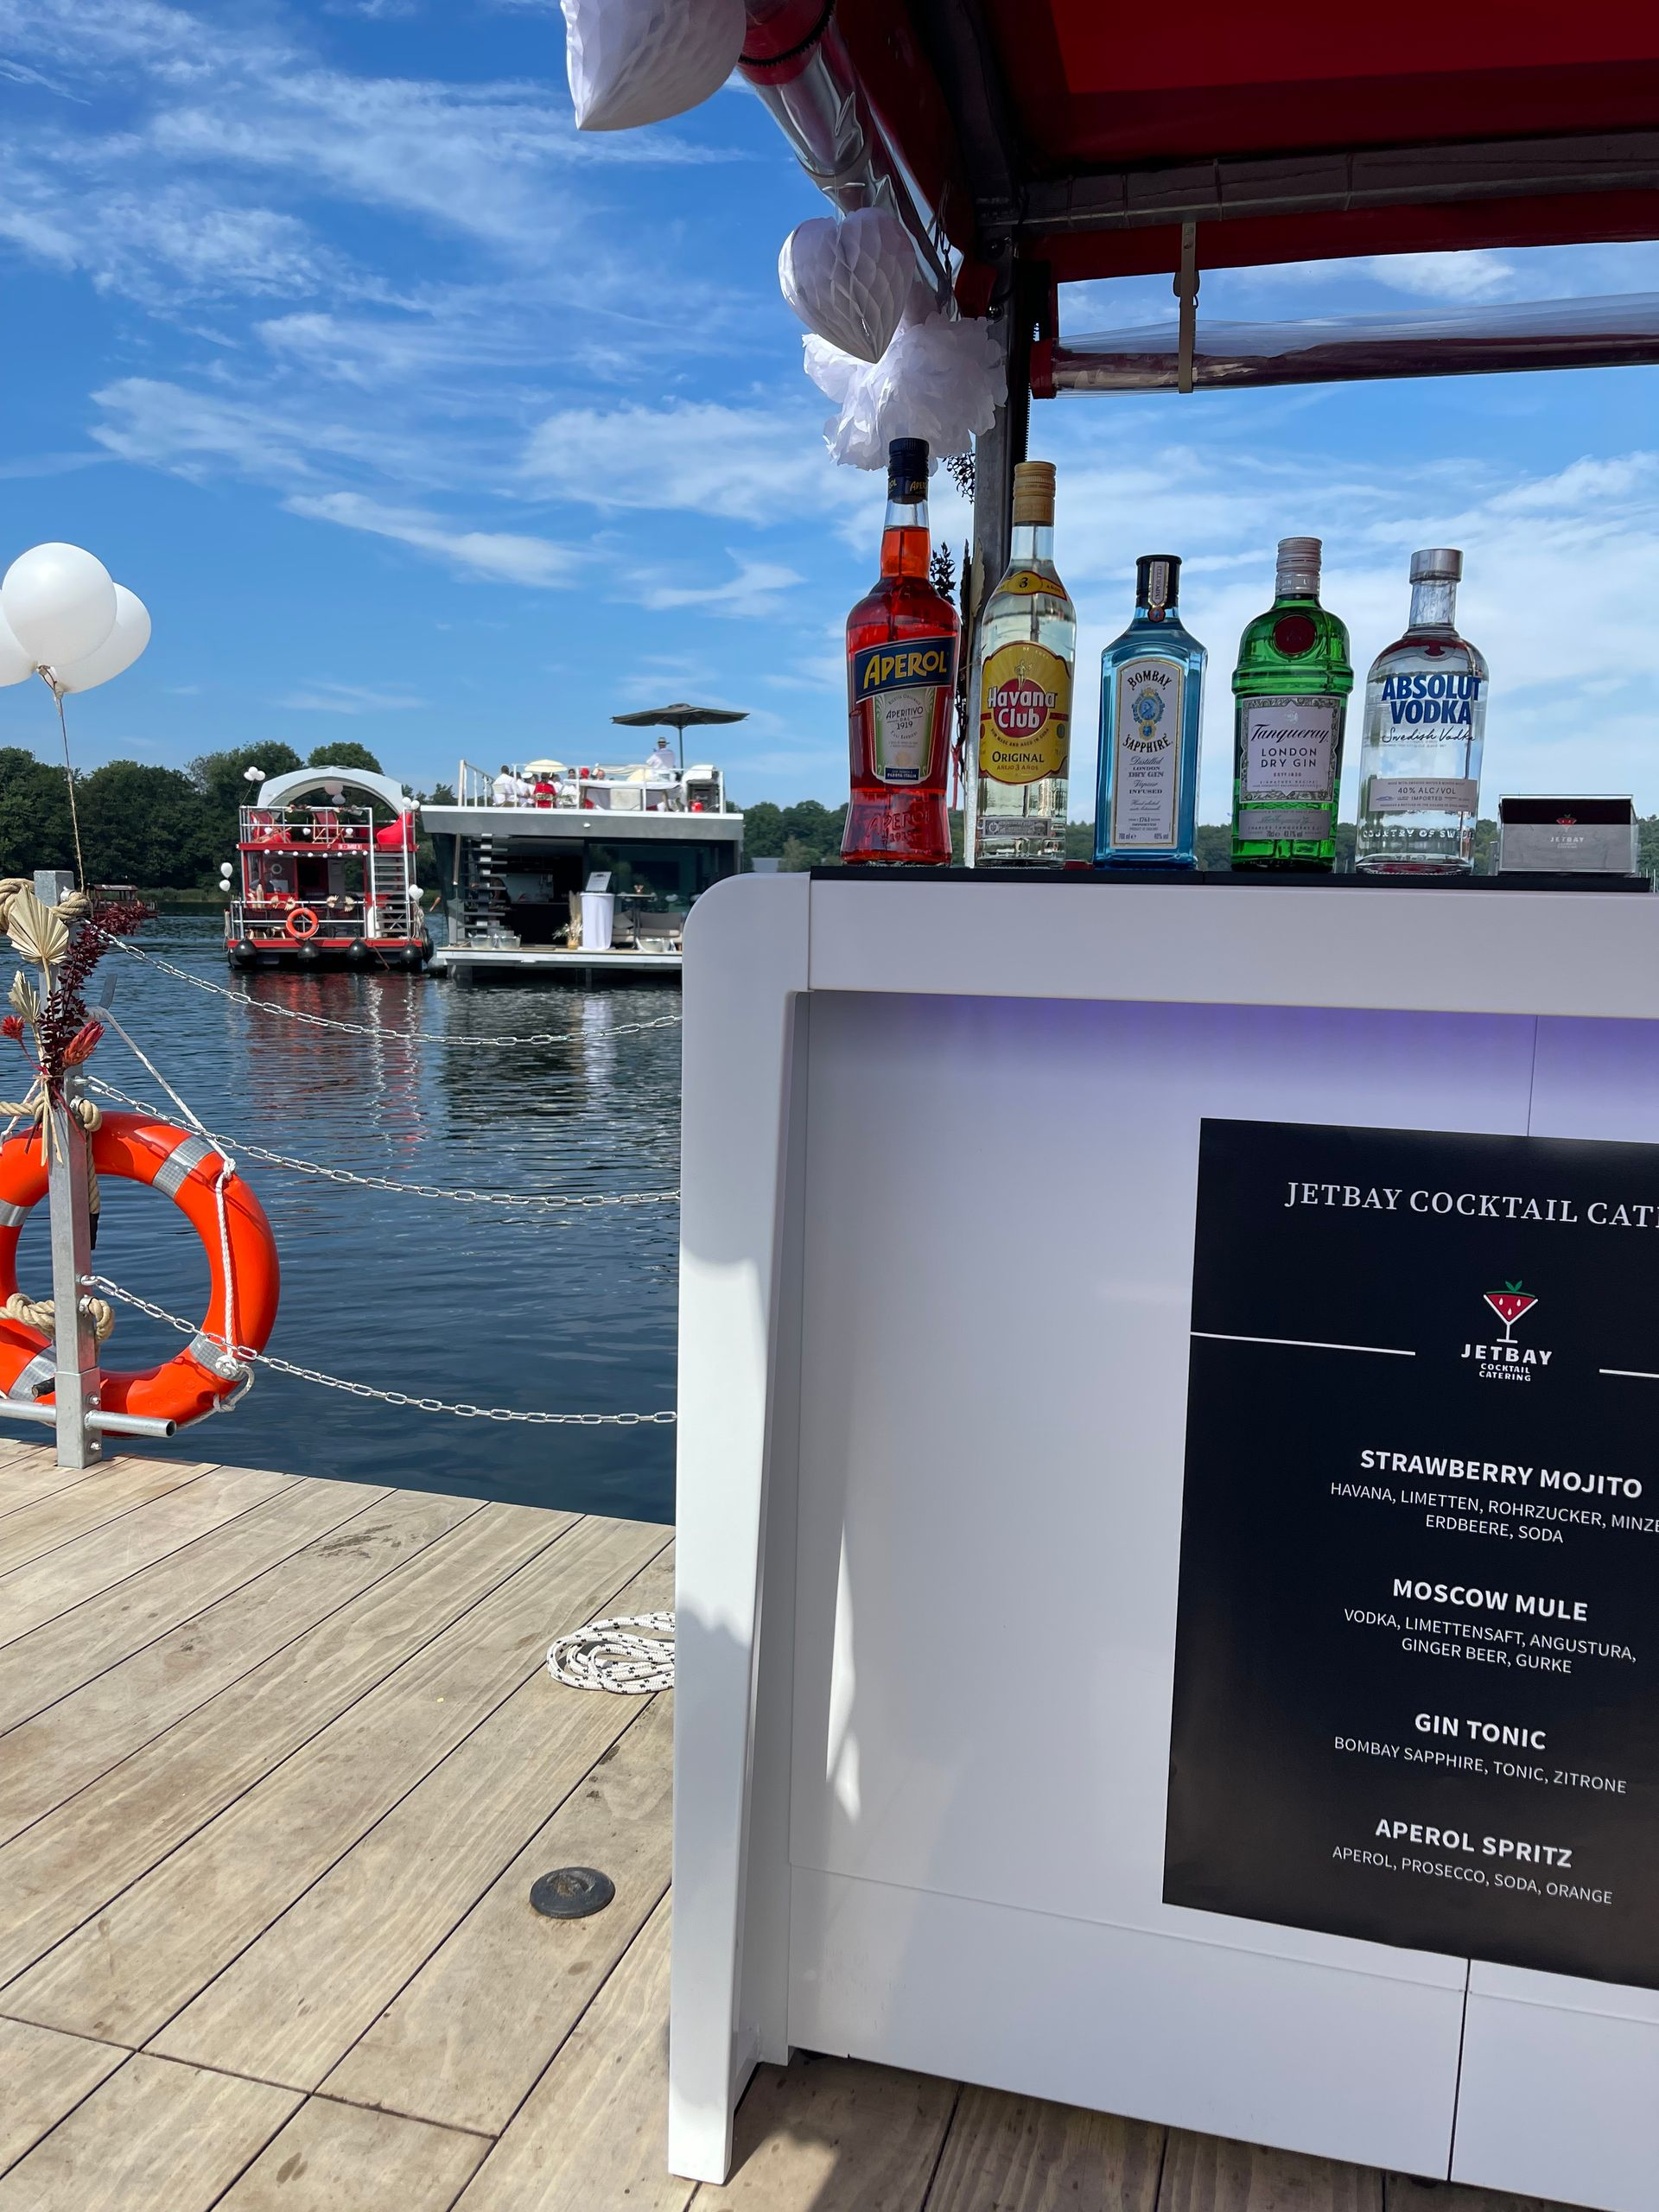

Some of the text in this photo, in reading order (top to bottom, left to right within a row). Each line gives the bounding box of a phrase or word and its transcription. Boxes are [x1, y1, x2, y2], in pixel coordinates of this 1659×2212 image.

[1020, 577, 1028, 588] 3
[863, 651, 947, 690] APEROL
[1128, 670, 1172, 690] BOMBAY
[988, 686, 1056, 709] Havana
[1382, 674, 1481, 701] ABSOLUT
[886, 706, 924, 719] APERITIVO
[998, 709, 1040, 728] Club
[1390, 700, 1471, 725] VODKA
[897, 721, 913, 731] 1919
[1250, 724, 1330, 744] Tanqueray
[1382, 726, 1476, 743] Swedish Vodka
[1122, 734, 1171, 753] SAPPHIRE
[1262, 747, 1317, 757] LONDON
[992, 751, 1045, 763] ORIGINAL
[1261, 759, 1317, 768] DRY GIN
[1284, 1182, 1659, 1228] JETBAY COCKTAIL CAT
[1461, 1344, 1553, 1365] JETBAY
[1478, 1371, 1531, 1382] CATERING
[1480, 1363, 1530, 1374] COCKTAIL
[1360, 1449, 1642, 1498] STRAWBERRY MOJITO
[1331, 1482, 1396, 1504] HAVANA,
[1401, 1490, 1484, 1515] LIMETTEN,
[1489, 1500, 1606, 1529] ROHRZUCKER,
[1426, 1514, 1564, 1543] ERDBEERE, SODA
[1393, 1579, 1588, 1622] MOSCOW MULE
[1344, 1608, 1637, 1663] VODKA, LIMETTENSAFT, ANGUSTURA,
[1402, 1637, 1573, 1674] GINGER BEER, GURKE
[1414, 1713, 1547, 1750] GIN TONIC
[1334, 1736, 1627, 1794] BOMBAY SAPPHIRE, TONIC, ZITRONE
[1375, 1818, 1573, 1868] APEROL SPRITZ
[1332, 1846, 1613, 1904] APEROL, PROSECCO, SODA, ORANGE
